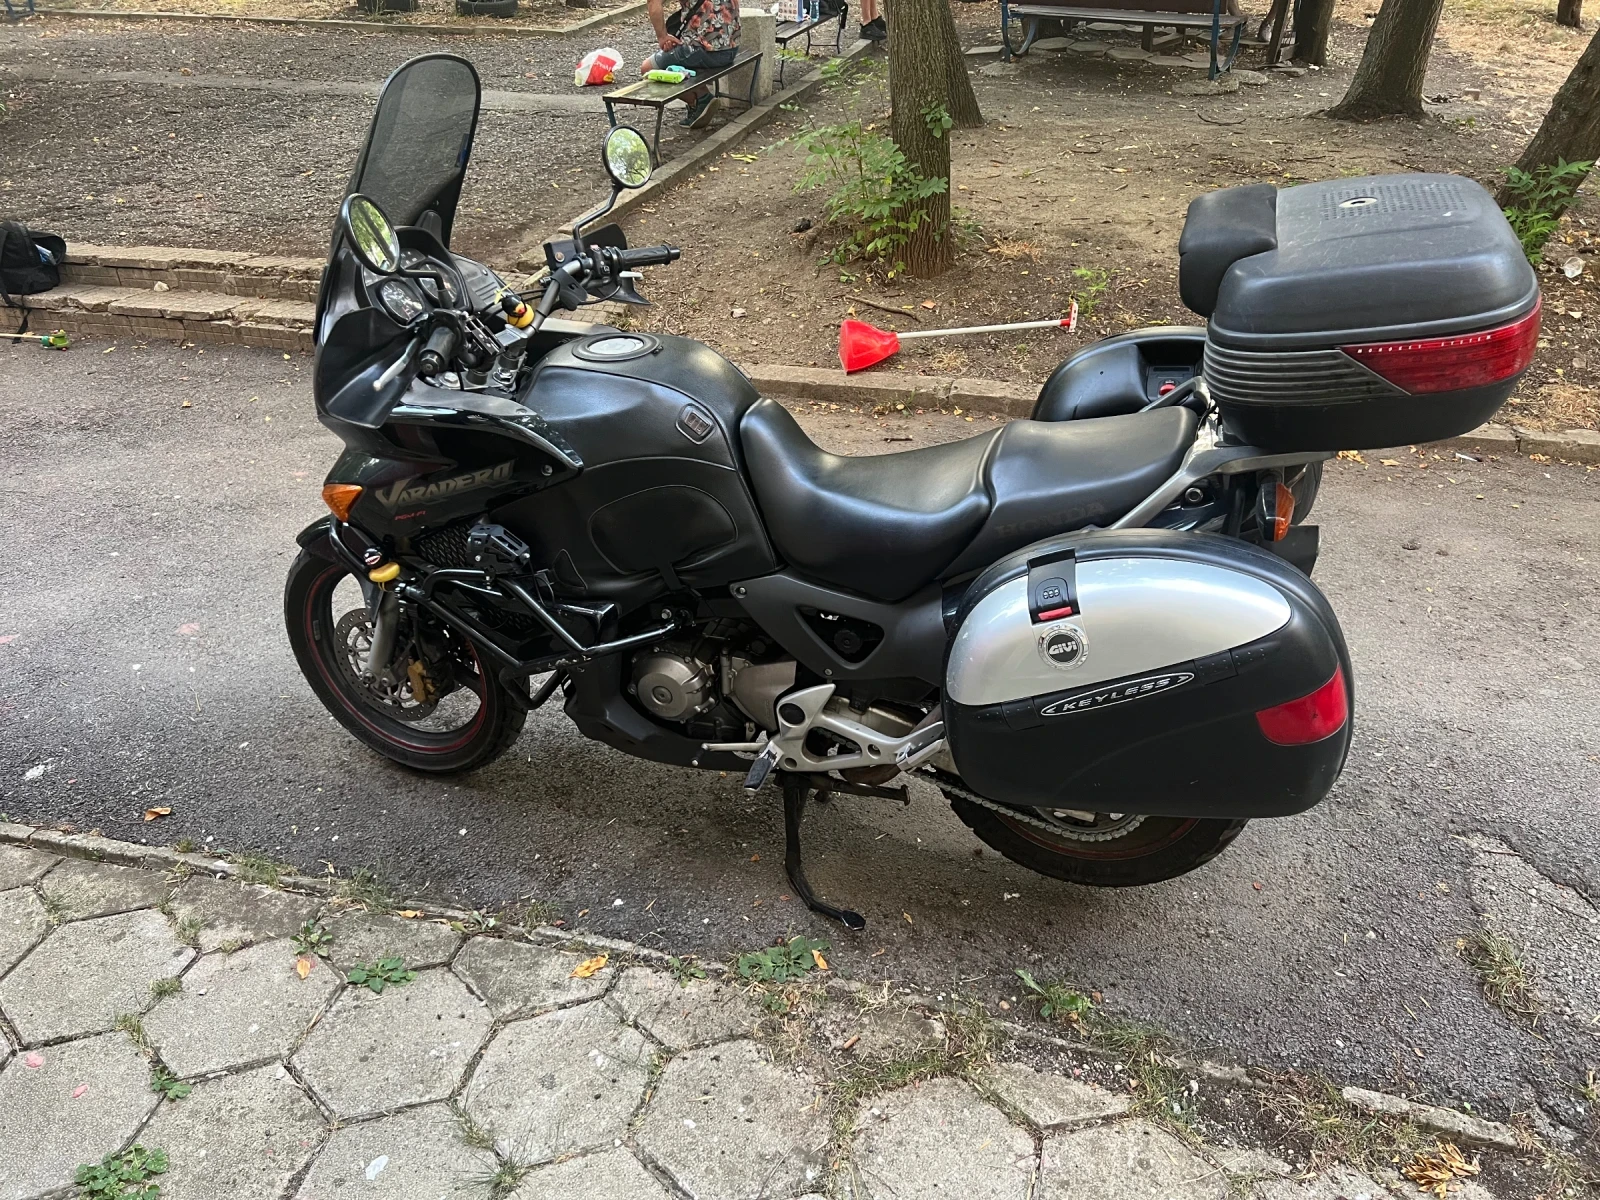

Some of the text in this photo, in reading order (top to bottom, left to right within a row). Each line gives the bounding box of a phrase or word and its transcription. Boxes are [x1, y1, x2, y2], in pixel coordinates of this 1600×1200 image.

[375, 460, 516, 515] VARADERO
[993, 502, 1106, 537] HONDA
[1049, 640, 1078, 655] GIVI
[1062, 678, 1171, 711] KEYLESS
